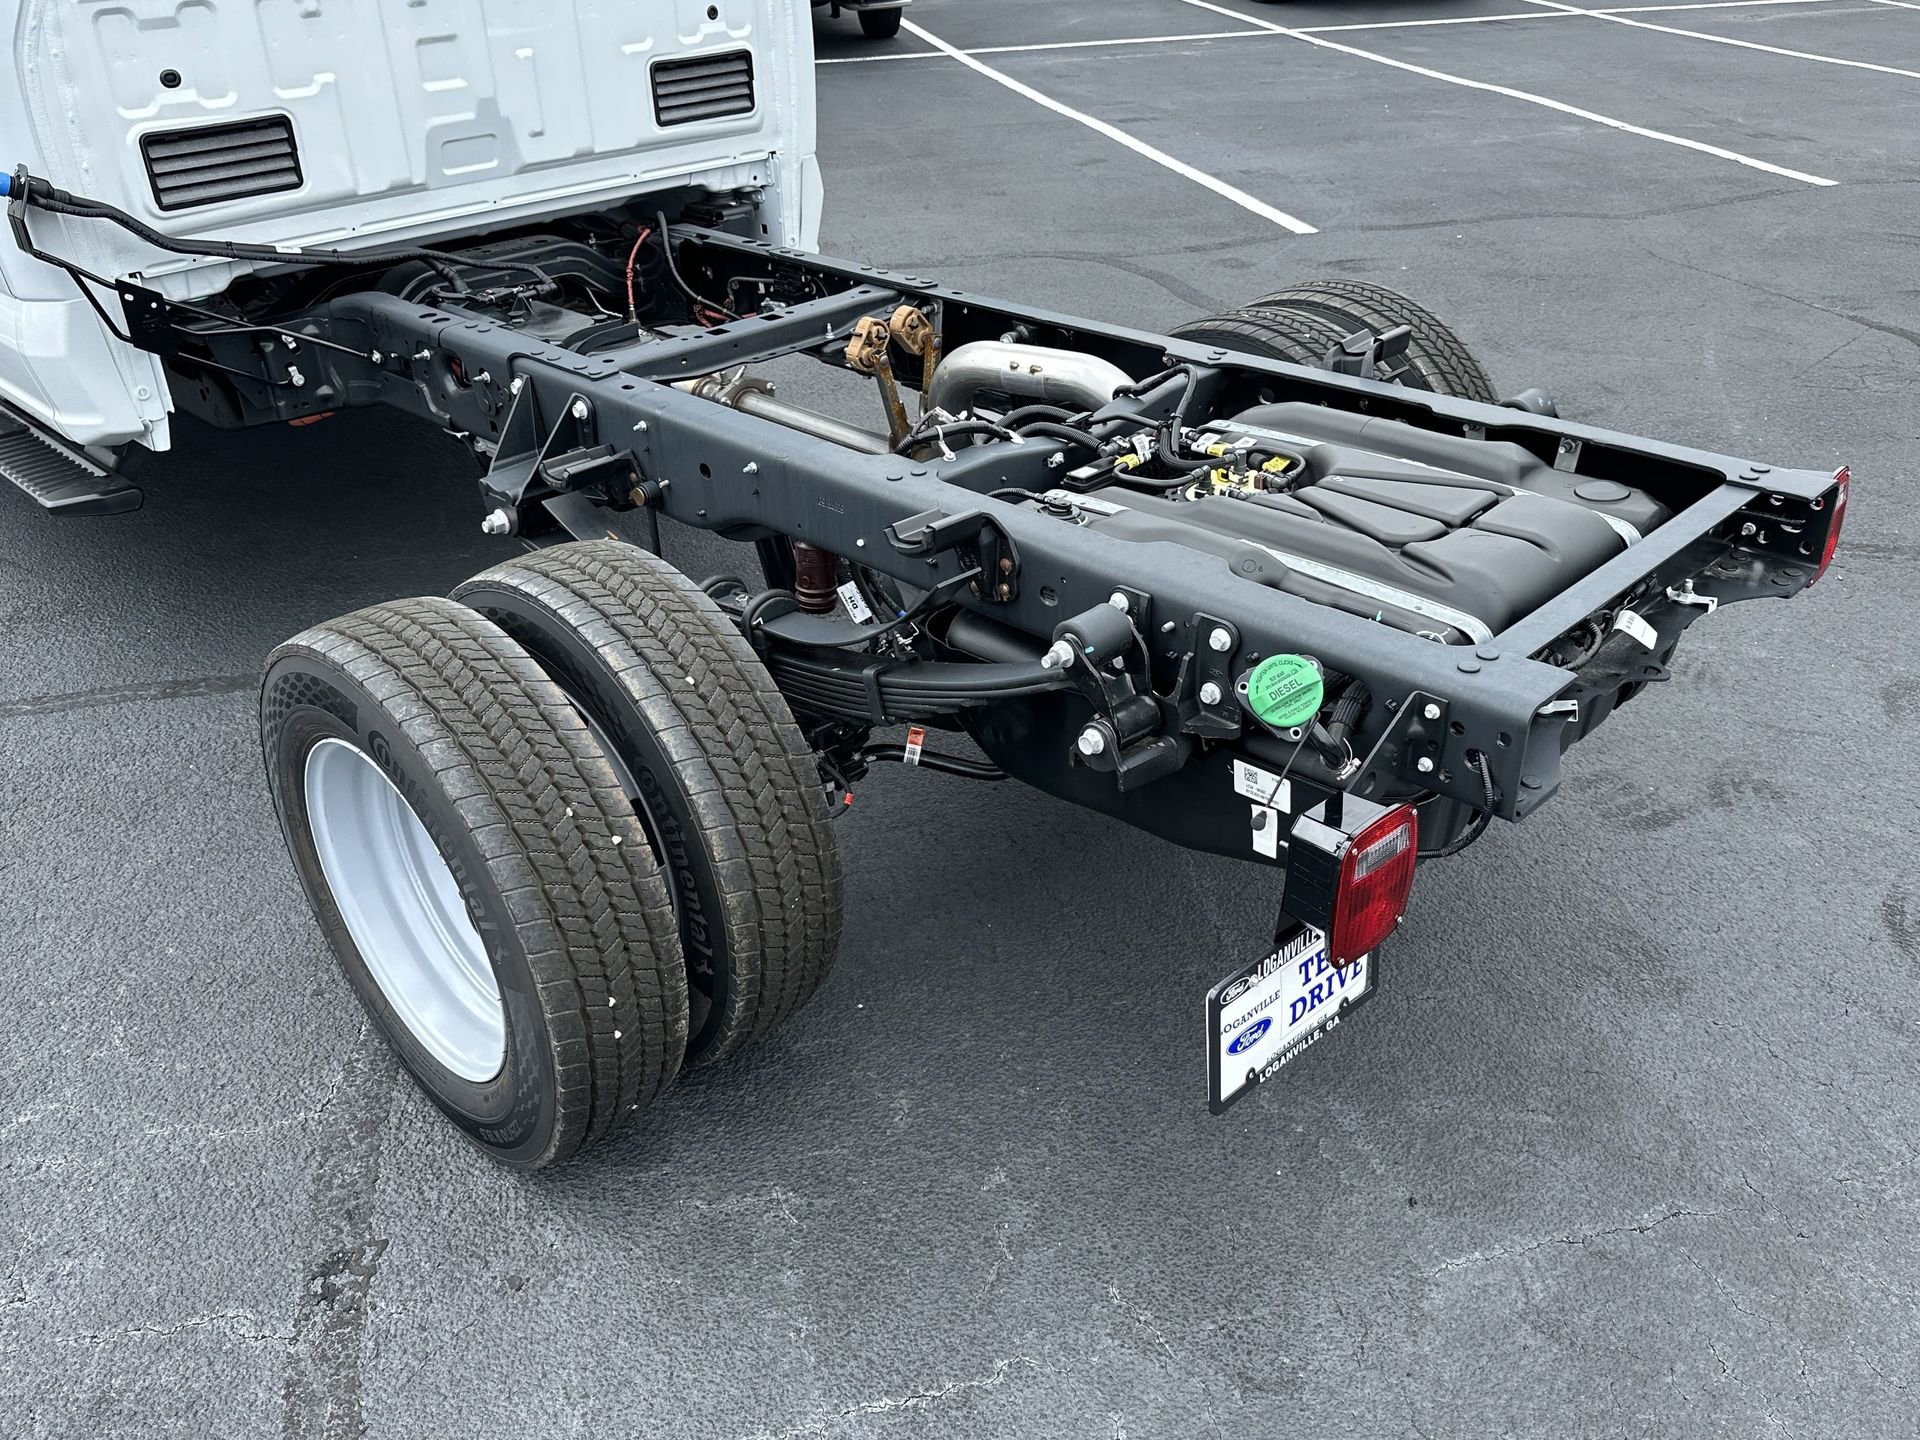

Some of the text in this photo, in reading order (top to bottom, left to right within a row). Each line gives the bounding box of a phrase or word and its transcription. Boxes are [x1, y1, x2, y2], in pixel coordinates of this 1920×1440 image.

[1269, 678, 1303, 701] DIESEL
[367, 729, 500, 931] Continental
[634, 756, 714, 959] Continental
[1257, 929, 1318, 981] LOGANVILLE
[1299, 947, 1330, 987] TE
[1220, 989, 1281, 1036] OGANVILLE
[1289, 959, 1363, 1027] DRIVE
[1259, 1015, 1340, 1083] LOGANVILLE, GA
